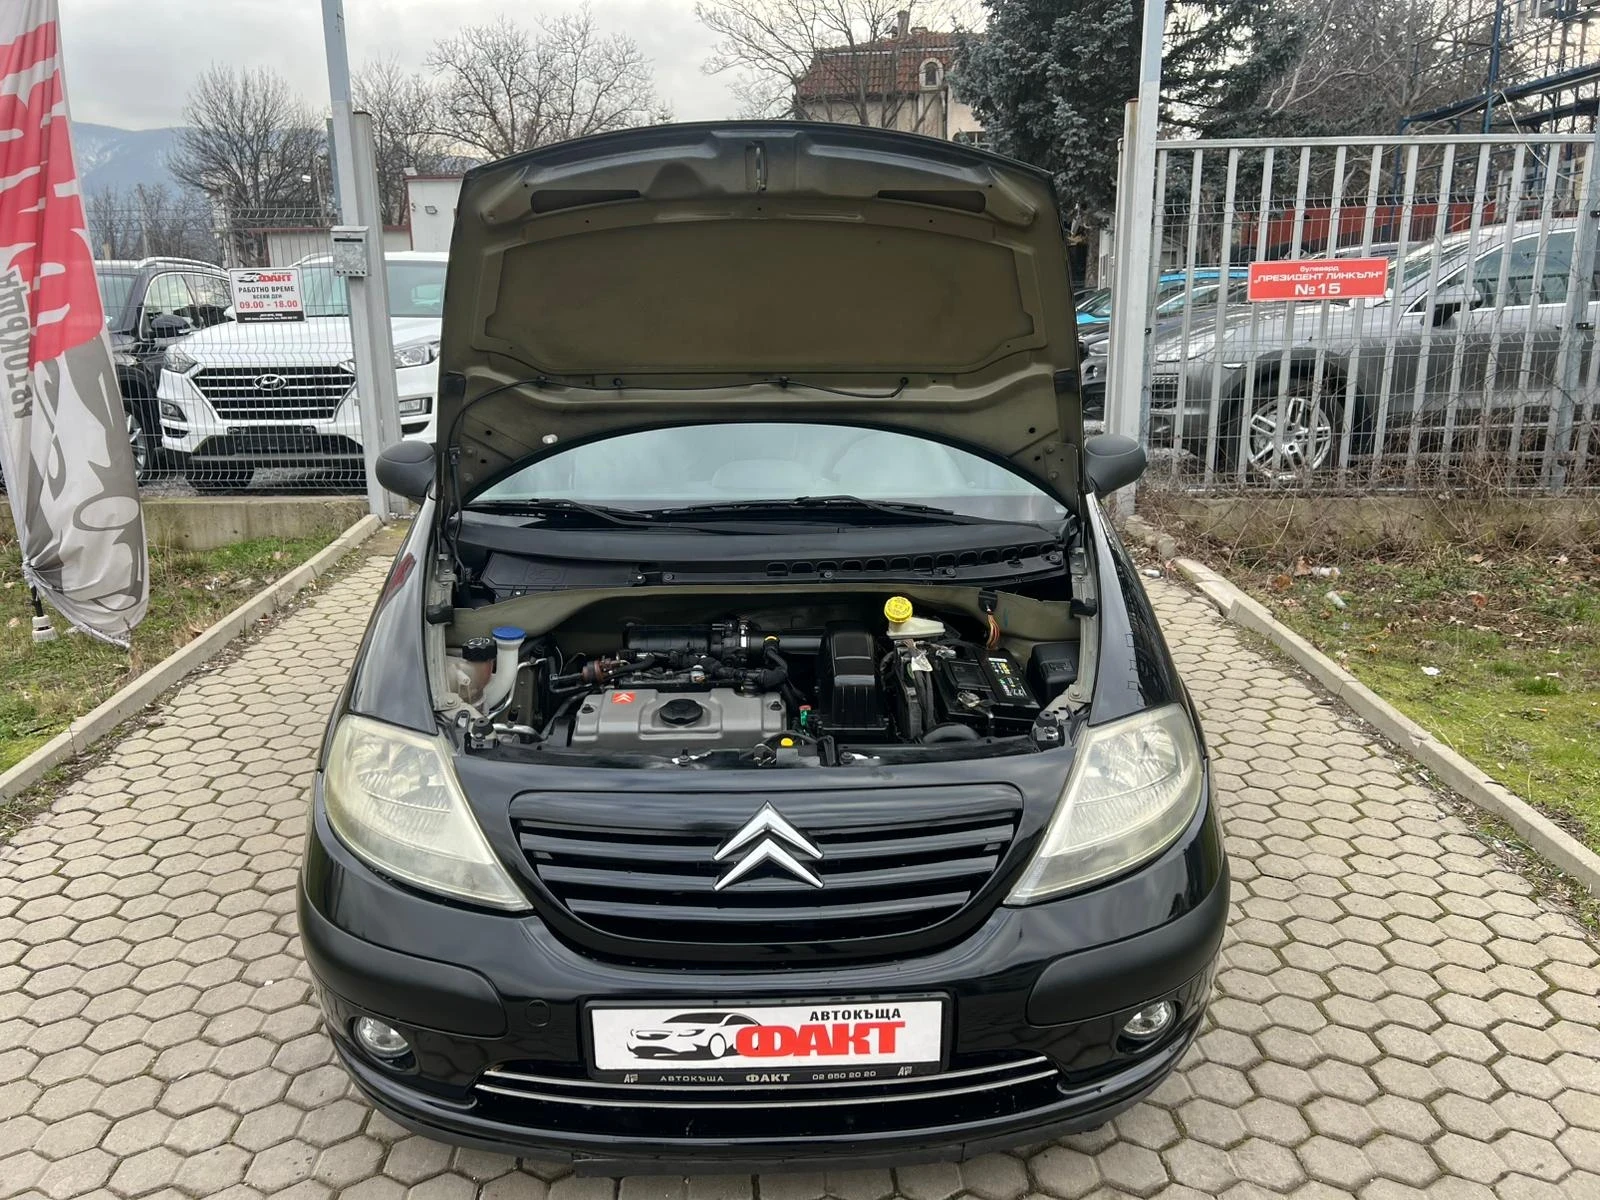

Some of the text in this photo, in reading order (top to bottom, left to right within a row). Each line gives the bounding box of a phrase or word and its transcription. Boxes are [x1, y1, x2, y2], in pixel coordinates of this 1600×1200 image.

[240, 301, 264, 309] 09.00
[274, 300, 298, 308] 18.00
[809, 1008, 901, 1022] АВТОКЪЩА
[735, 1021, 906, 1058] ФАКТ
[745, 1073, 791, 1083] ФАКТ
